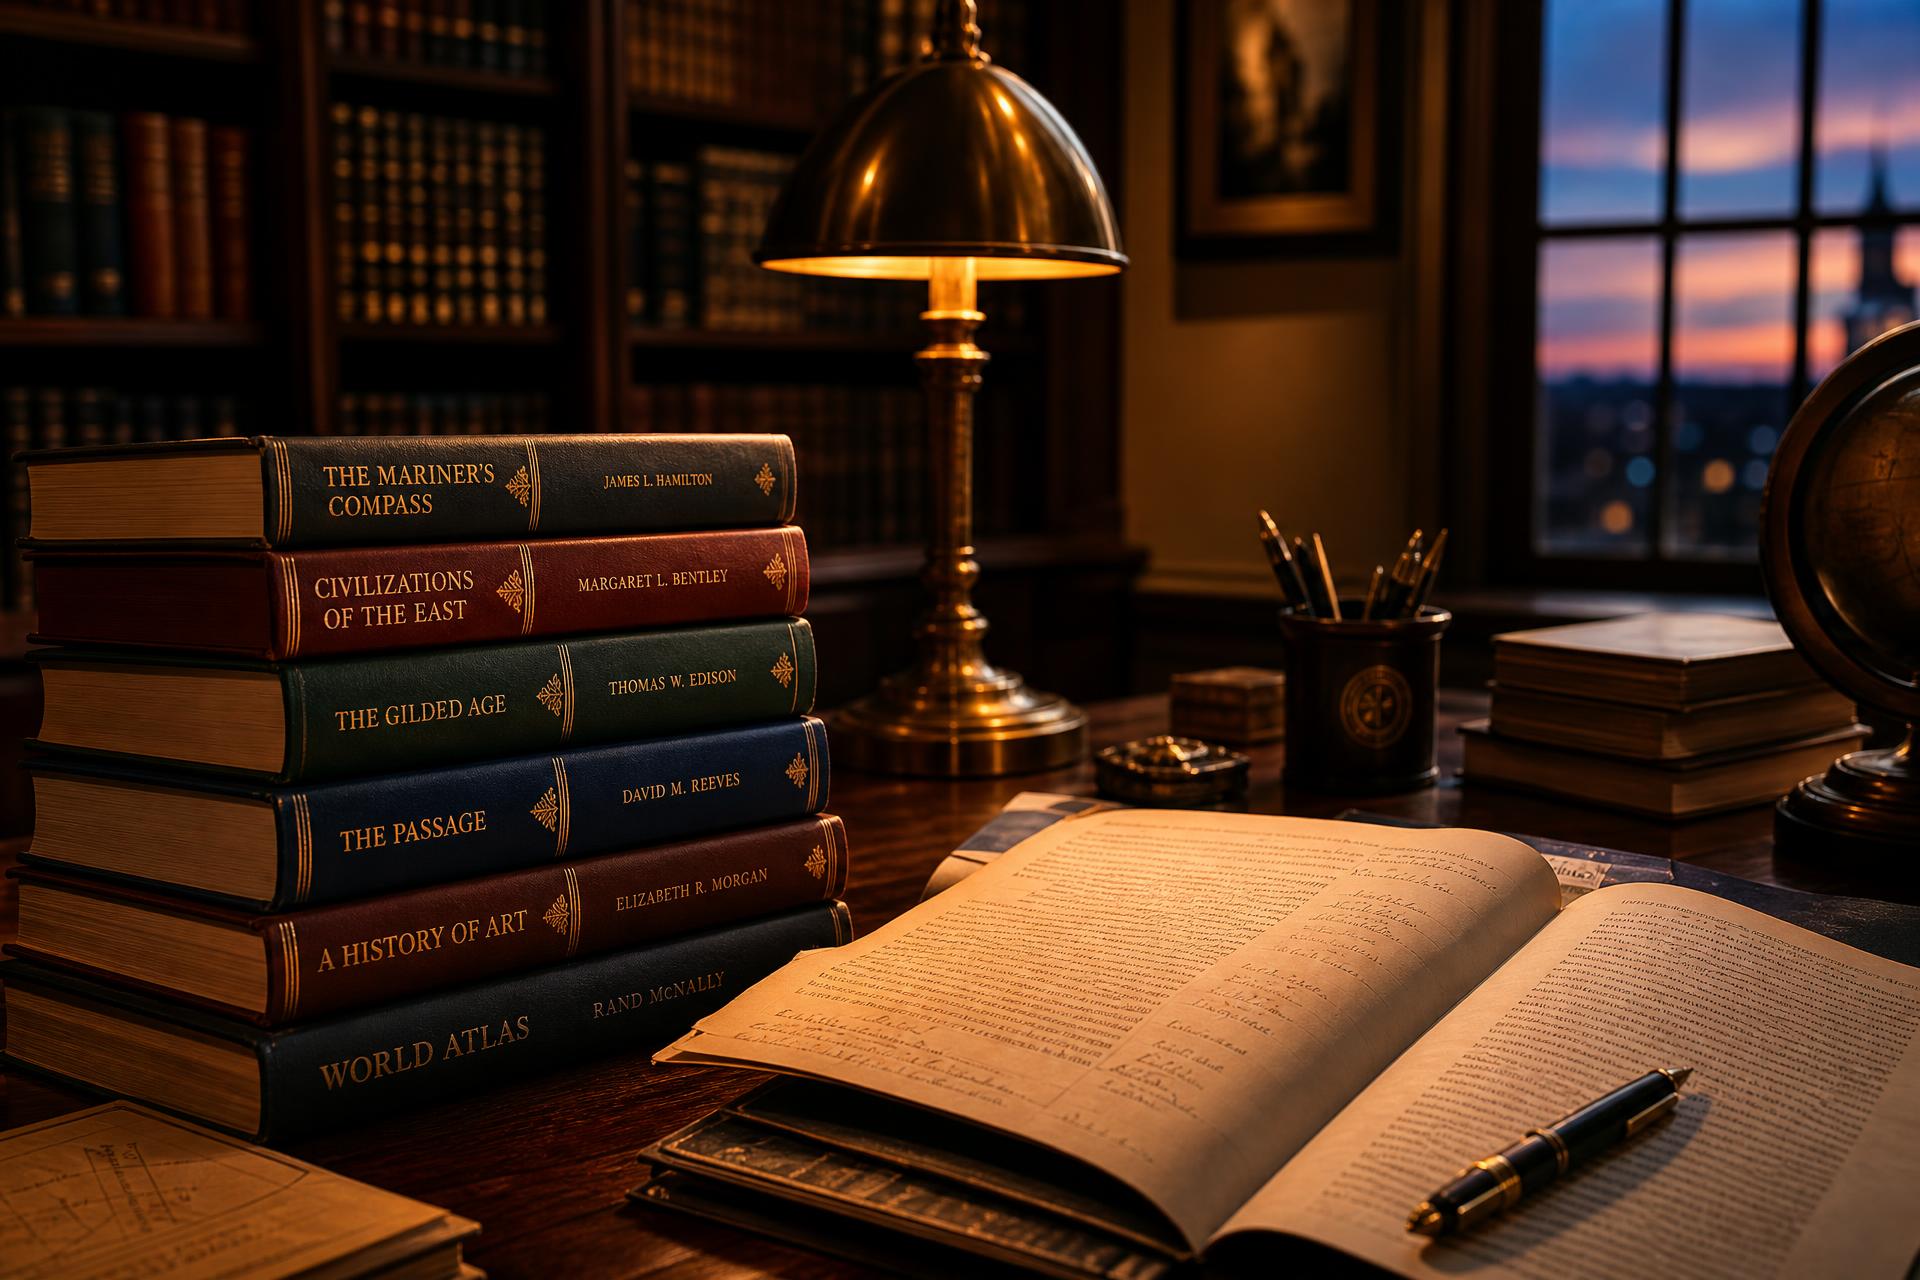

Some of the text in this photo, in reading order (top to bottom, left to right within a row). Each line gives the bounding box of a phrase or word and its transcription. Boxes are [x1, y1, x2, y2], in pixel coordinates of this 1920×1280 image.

[323, 463, 495, 487] THE MARINER’S
[604, 474, 712, 489] JAMES L. HAMILTON
[329, 494, 432, 516] COMPASS
[315, 570, 474, 599] CIVILIZATIONS
[579, 569, 727, 591] MARGARET L. BENTLEY
[324, 600, 467, 629] OF THE EAST
[609, 669, 736, 695] THOMAS W. EDISON
[335, 695, 506, 730] THE GILDED AGE
[623, 773, 739, 803] DAVID M. REEVES
[340, 811, 486, 851] THE PASSAGE
[617, 868, 767, 911] ELIZABETH R. MORGAN
[318, 910, 527, 972] A HISTORY OF ART
[594, 972, 725, 1018] RAND McNALLY
[320, 1016, 529, 1089] WORLD ATLAS
